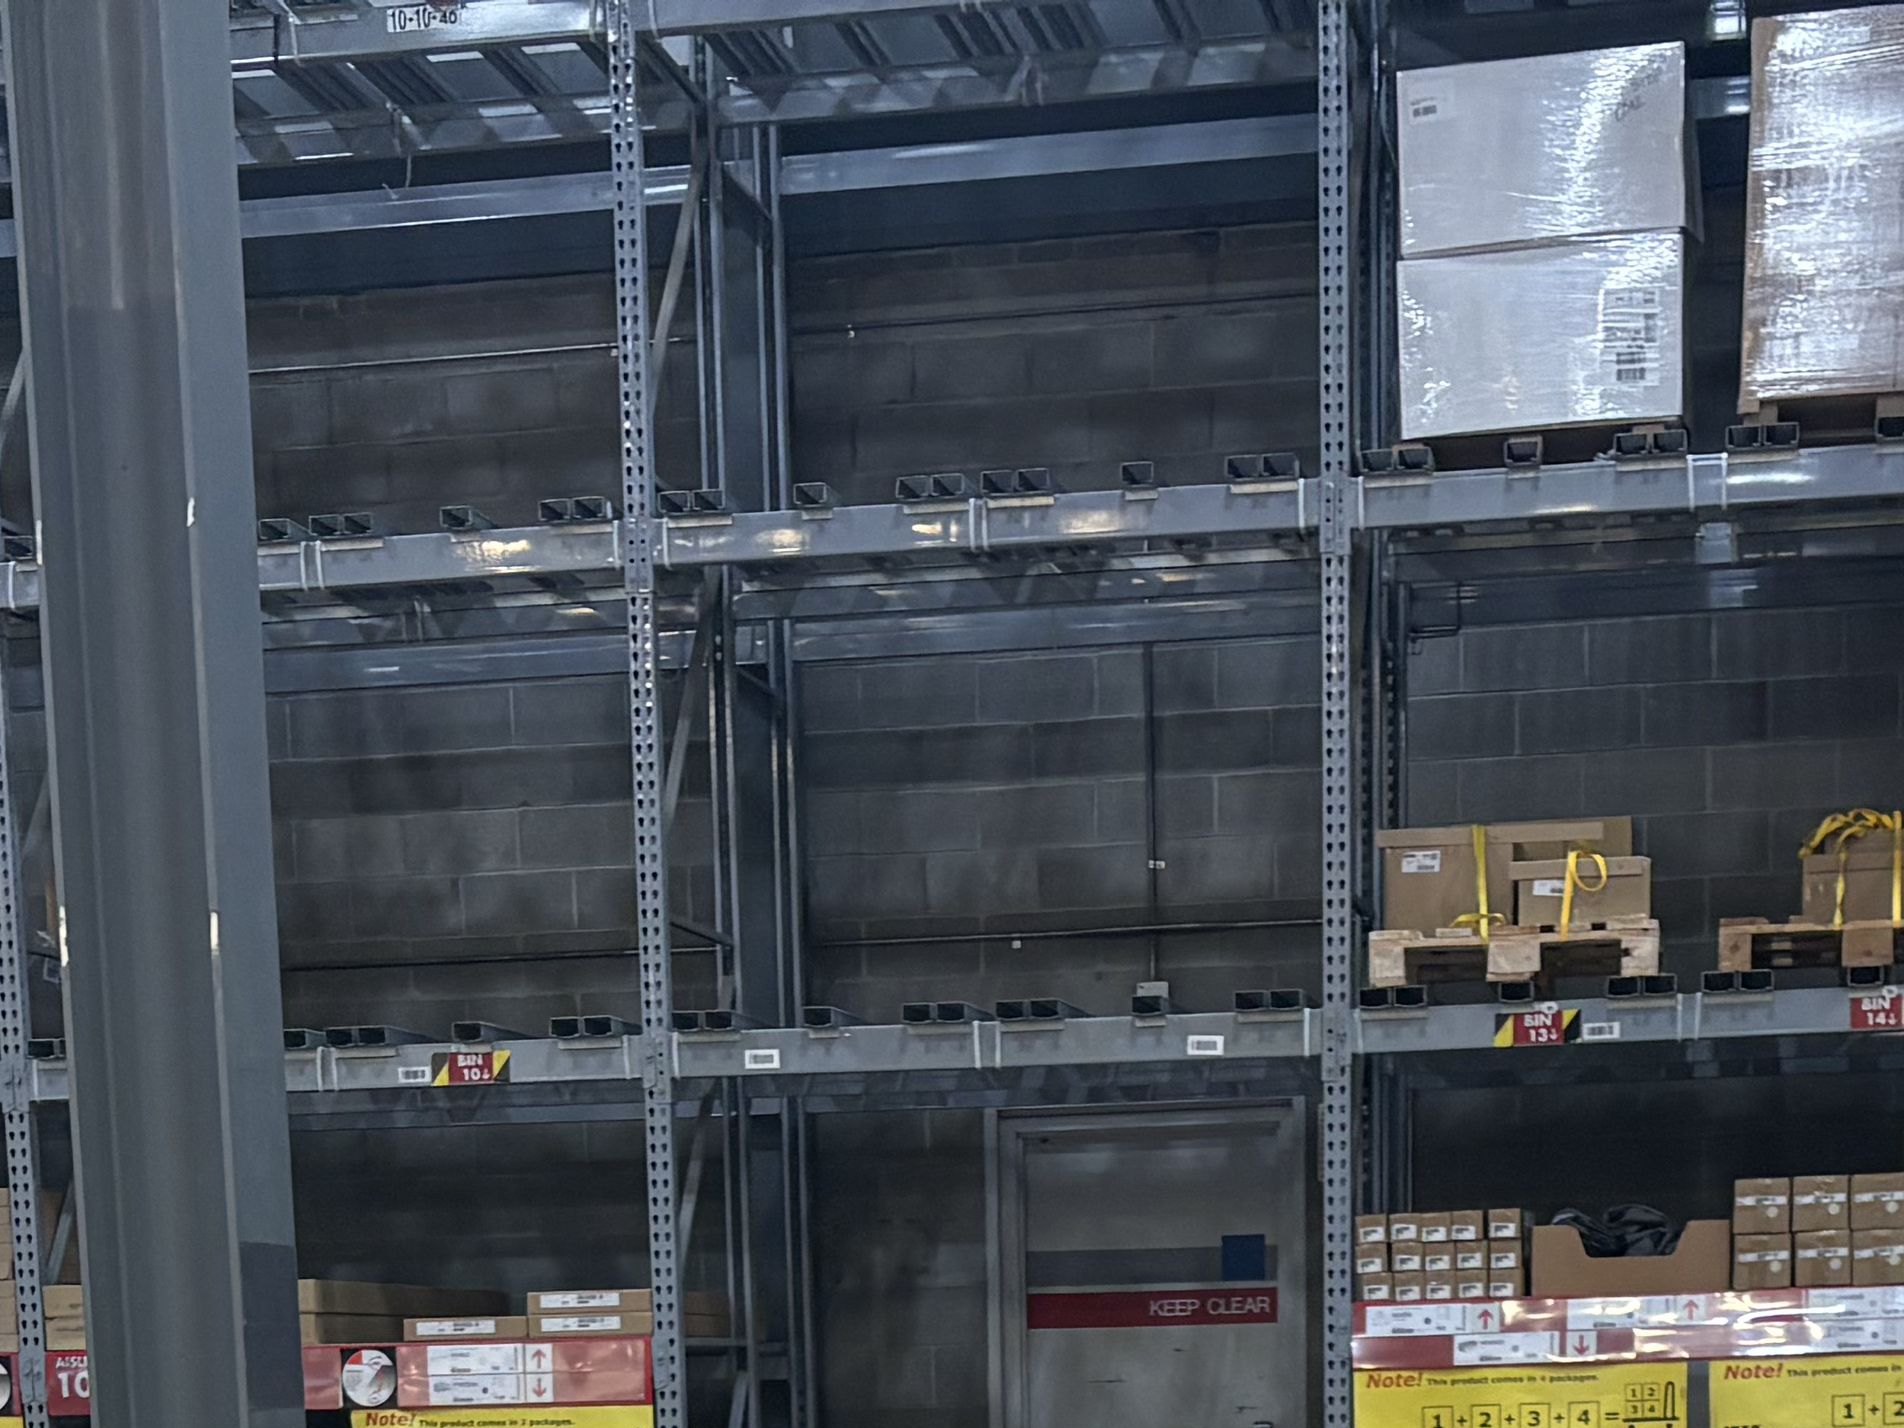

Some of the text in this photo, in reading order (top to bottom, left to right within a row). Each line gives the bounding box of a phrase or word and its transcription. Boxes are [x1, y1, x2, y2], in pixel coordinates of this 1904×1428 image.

[1861, 997, 1891, 1011] BIN
[1524, 1013, 1552, 1027] BIN
[1866, 1012, 1886, 1025] 14
[1528, 1028, 1548, 1042] 13
[458, 1054, 483, 1067] BIN
[463, 1068, 481, 1080] 10
[1149, 1297, 1270, 1316] KEEP CLEAR
[1724, 1363, 1783, 1380] Note!
[58, 1370, 90, 1398] 10
[1367, 1372, 1423, 1389] Note!
[1842, 1403, 1854, 1419] 1
[365, 1412, 416, 1426] Note!
[1479, 1413, 1491, 1428] 2
[1528, 1411, 1541, 1427] 3
[1577, 1410, 1590, 1425] 4
